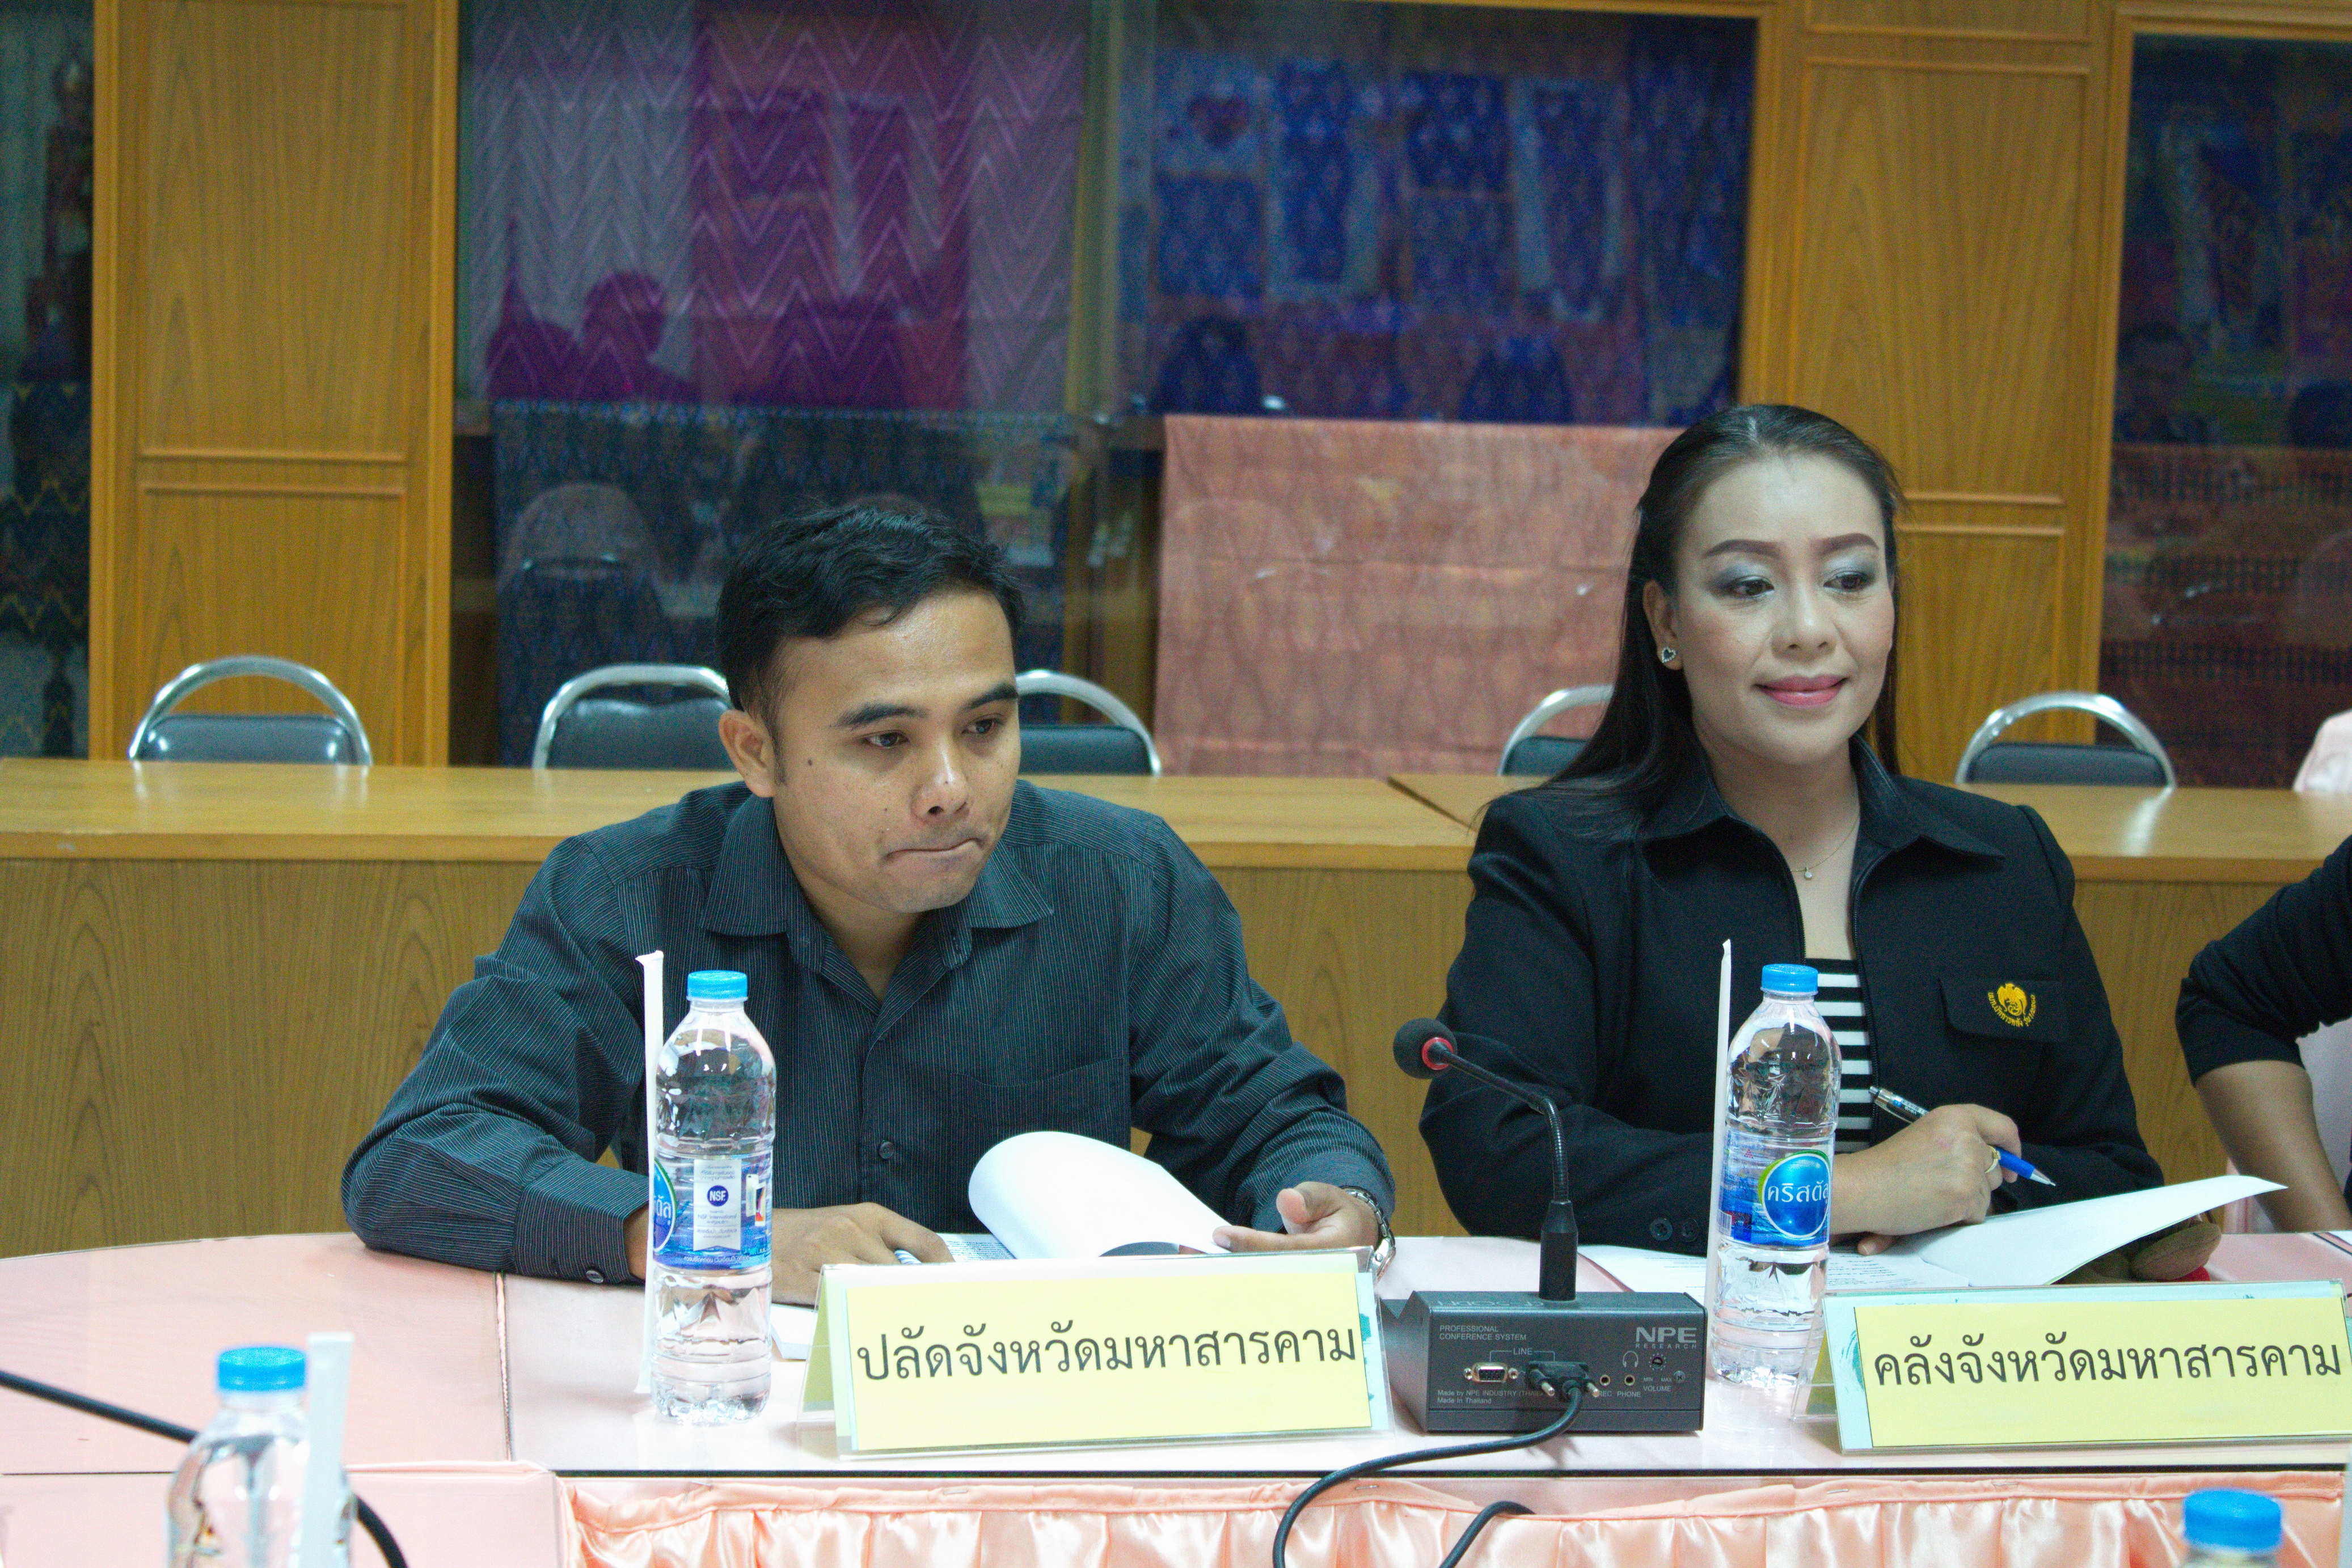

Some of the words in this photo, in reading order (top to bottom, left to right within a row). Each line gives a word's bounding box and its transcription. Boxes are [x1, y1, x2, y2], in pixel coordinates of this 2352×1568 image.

[857, 1320, 1356, 1380] ปลัดจังหวัดมหาสารคาม
[1636, 1327, 1697, 1343] NPE
[1874, 1331, 2342, 1385] คลังจังหวัดมหาสารคาม
